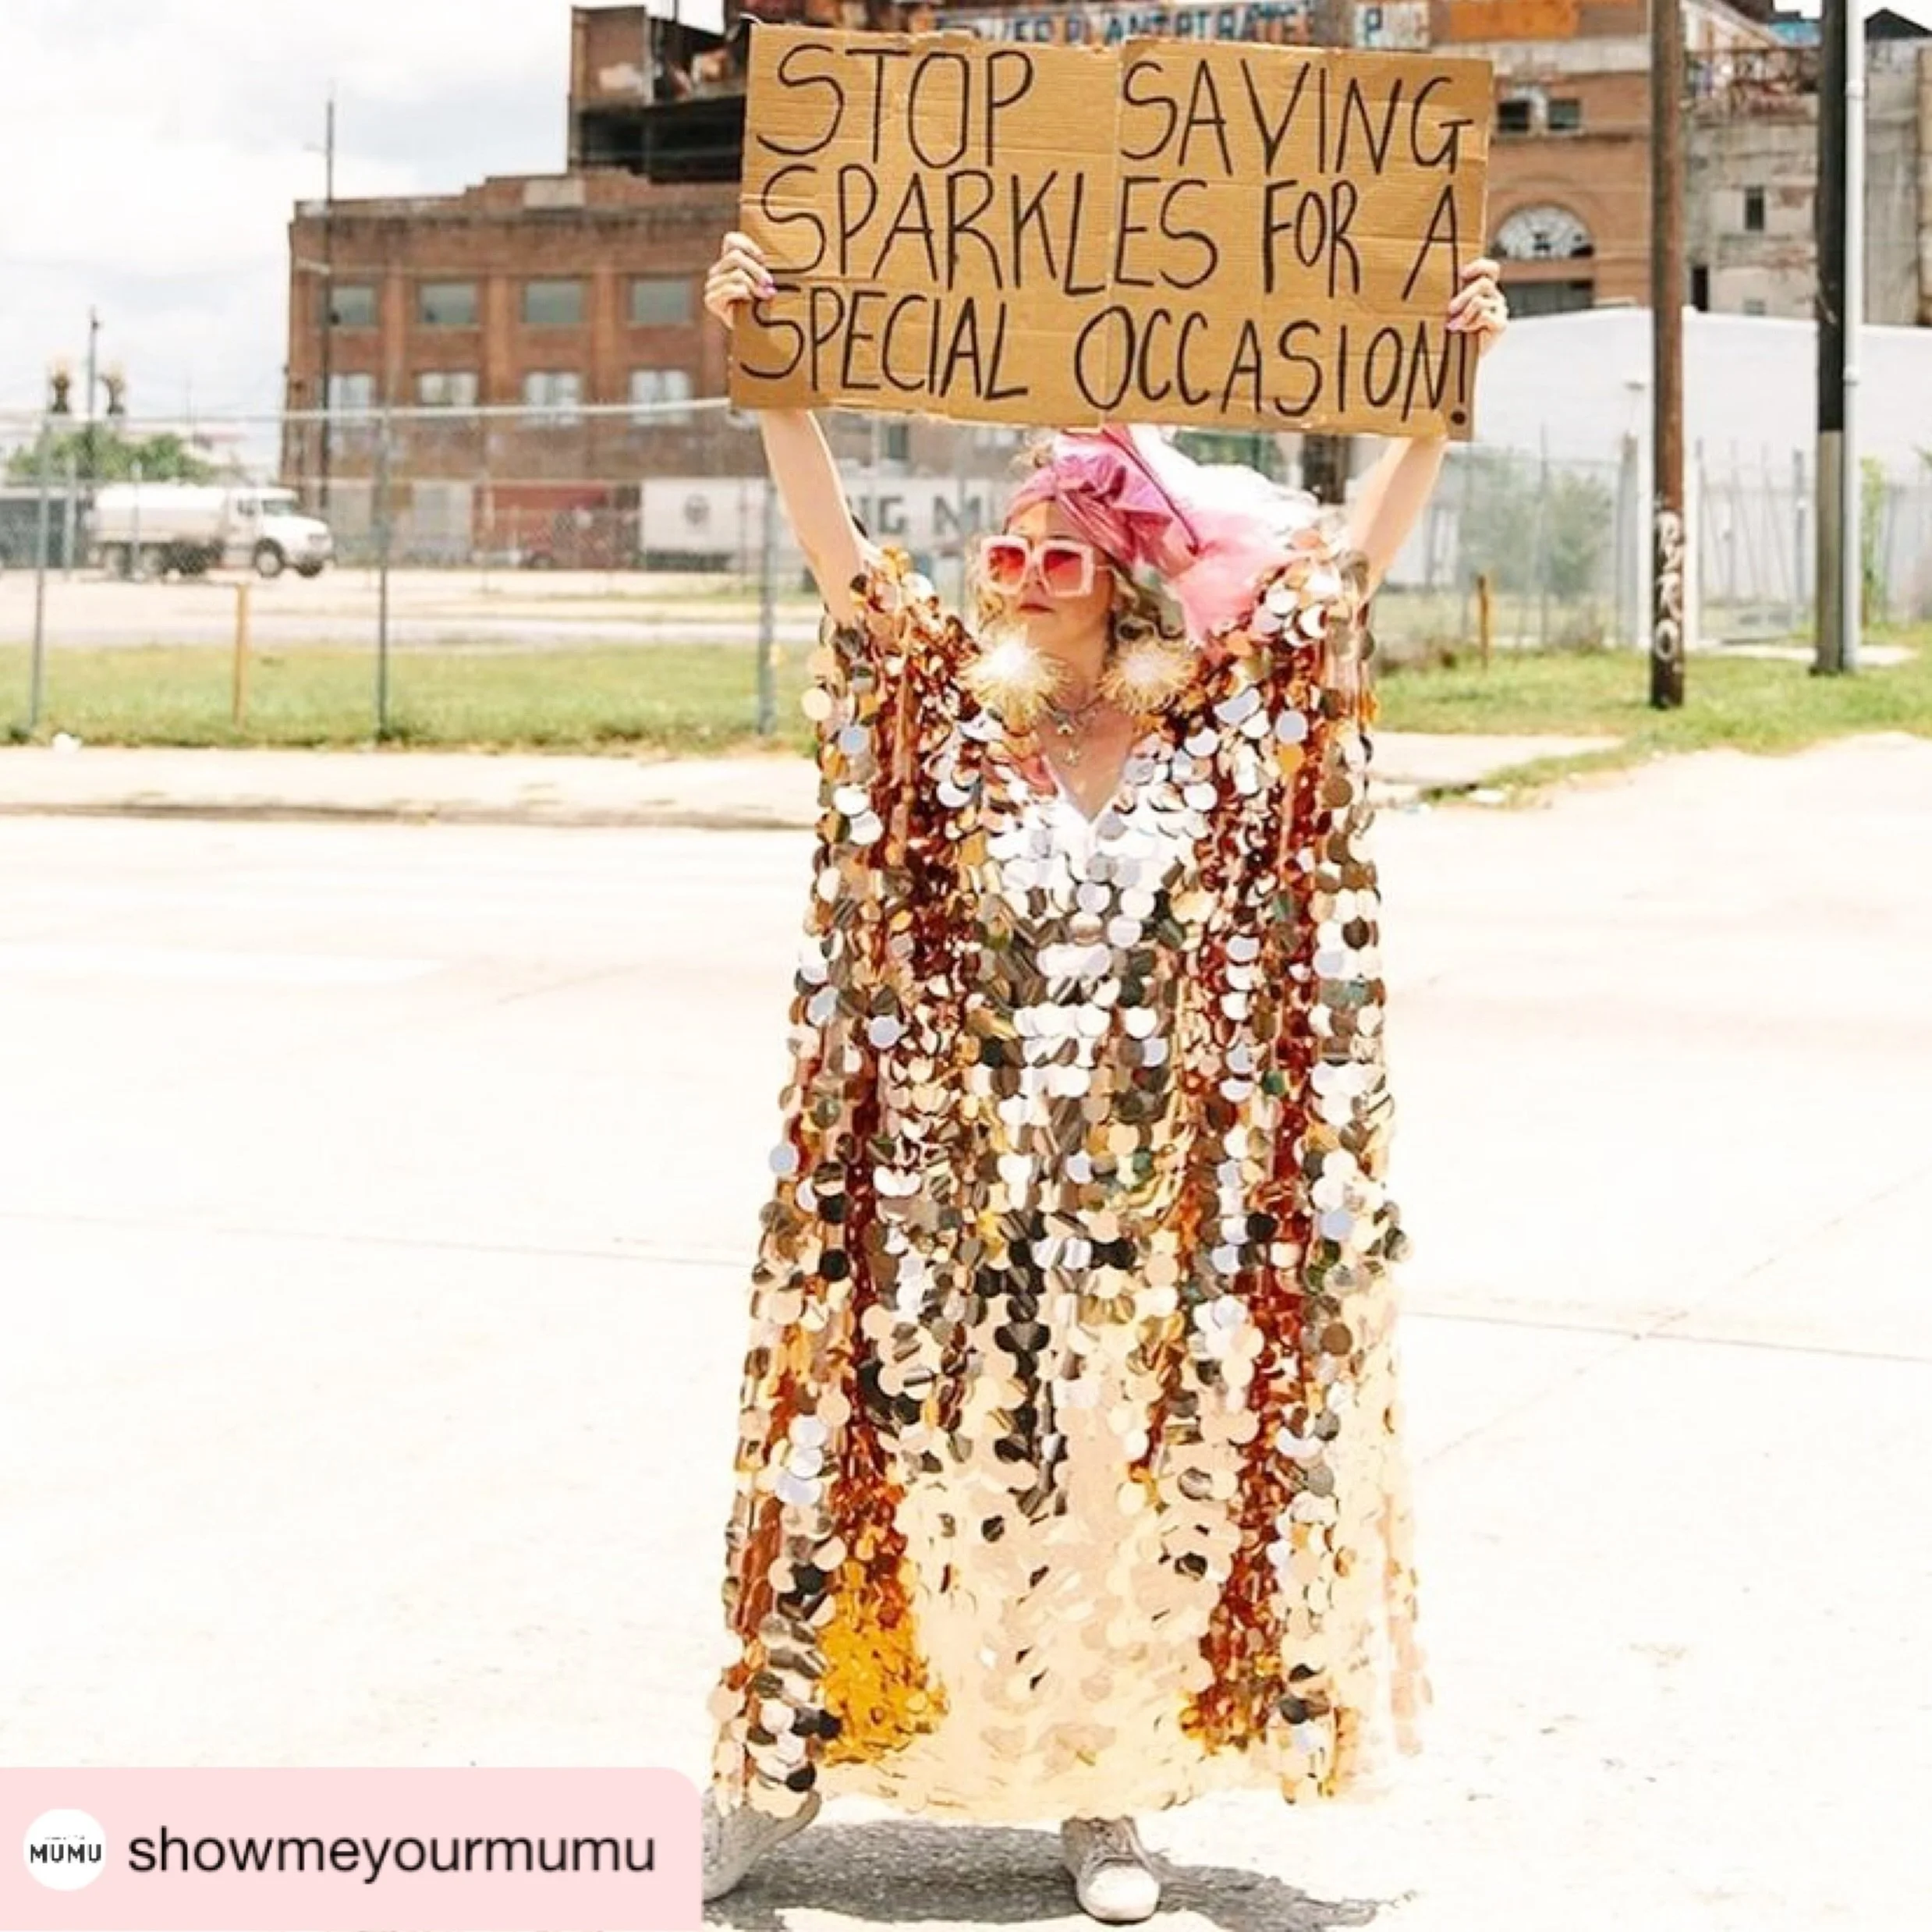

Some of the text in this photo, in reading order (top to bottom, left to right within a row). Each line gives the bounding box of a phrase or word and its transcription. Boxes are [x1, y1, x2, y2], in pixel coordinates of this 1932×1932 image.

[756, 44, 1473, 175] STOP SAVING
[760, 164, 1459, 300] SPARKLES FOR A
[739, 283, 1468, 425] SPECIAL OCCASION!
